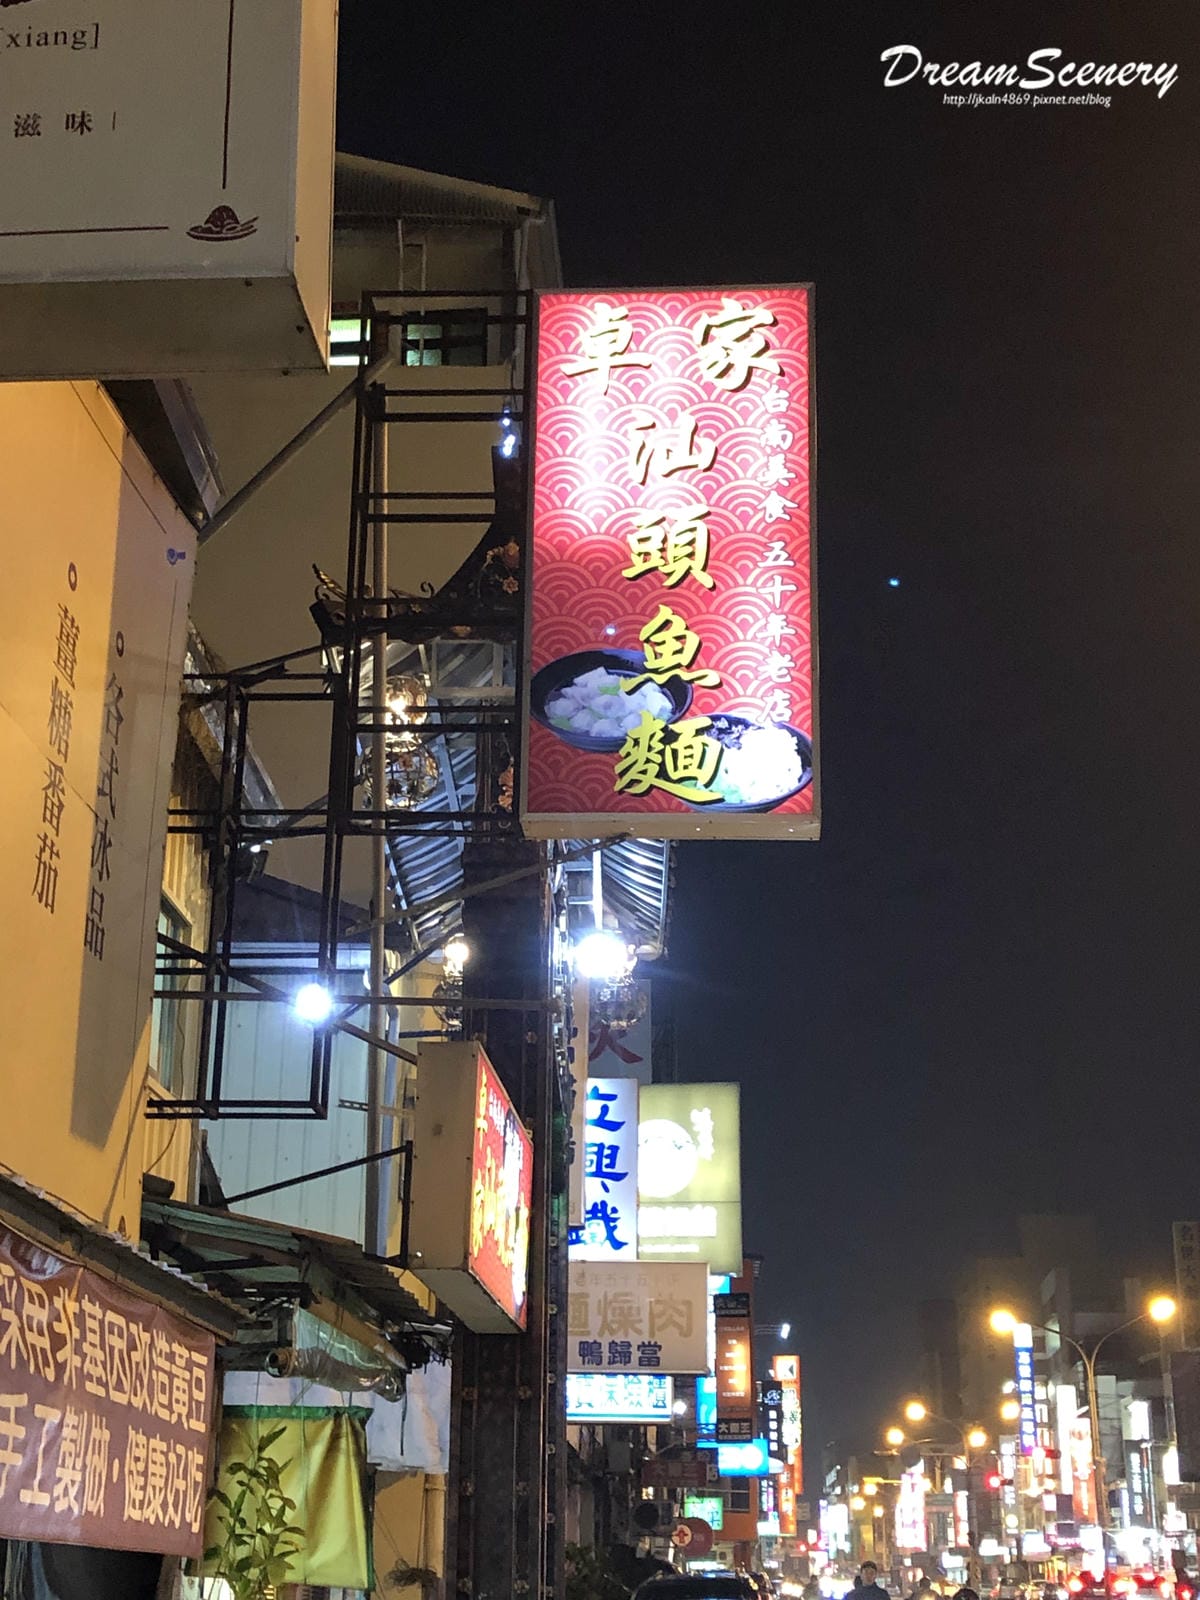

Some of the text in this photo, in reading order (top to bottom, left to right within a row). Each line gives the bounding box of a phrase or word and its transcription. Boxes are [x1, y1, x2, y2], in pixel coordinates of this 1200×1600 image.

[0, 23, 99, 53] xiang]
[613, 410, 724, 804] 汕頭魚麵
[756, 384, 798, 724] 台南美食 五十年老店
[84, 672, 124, 961] 各式冰品
